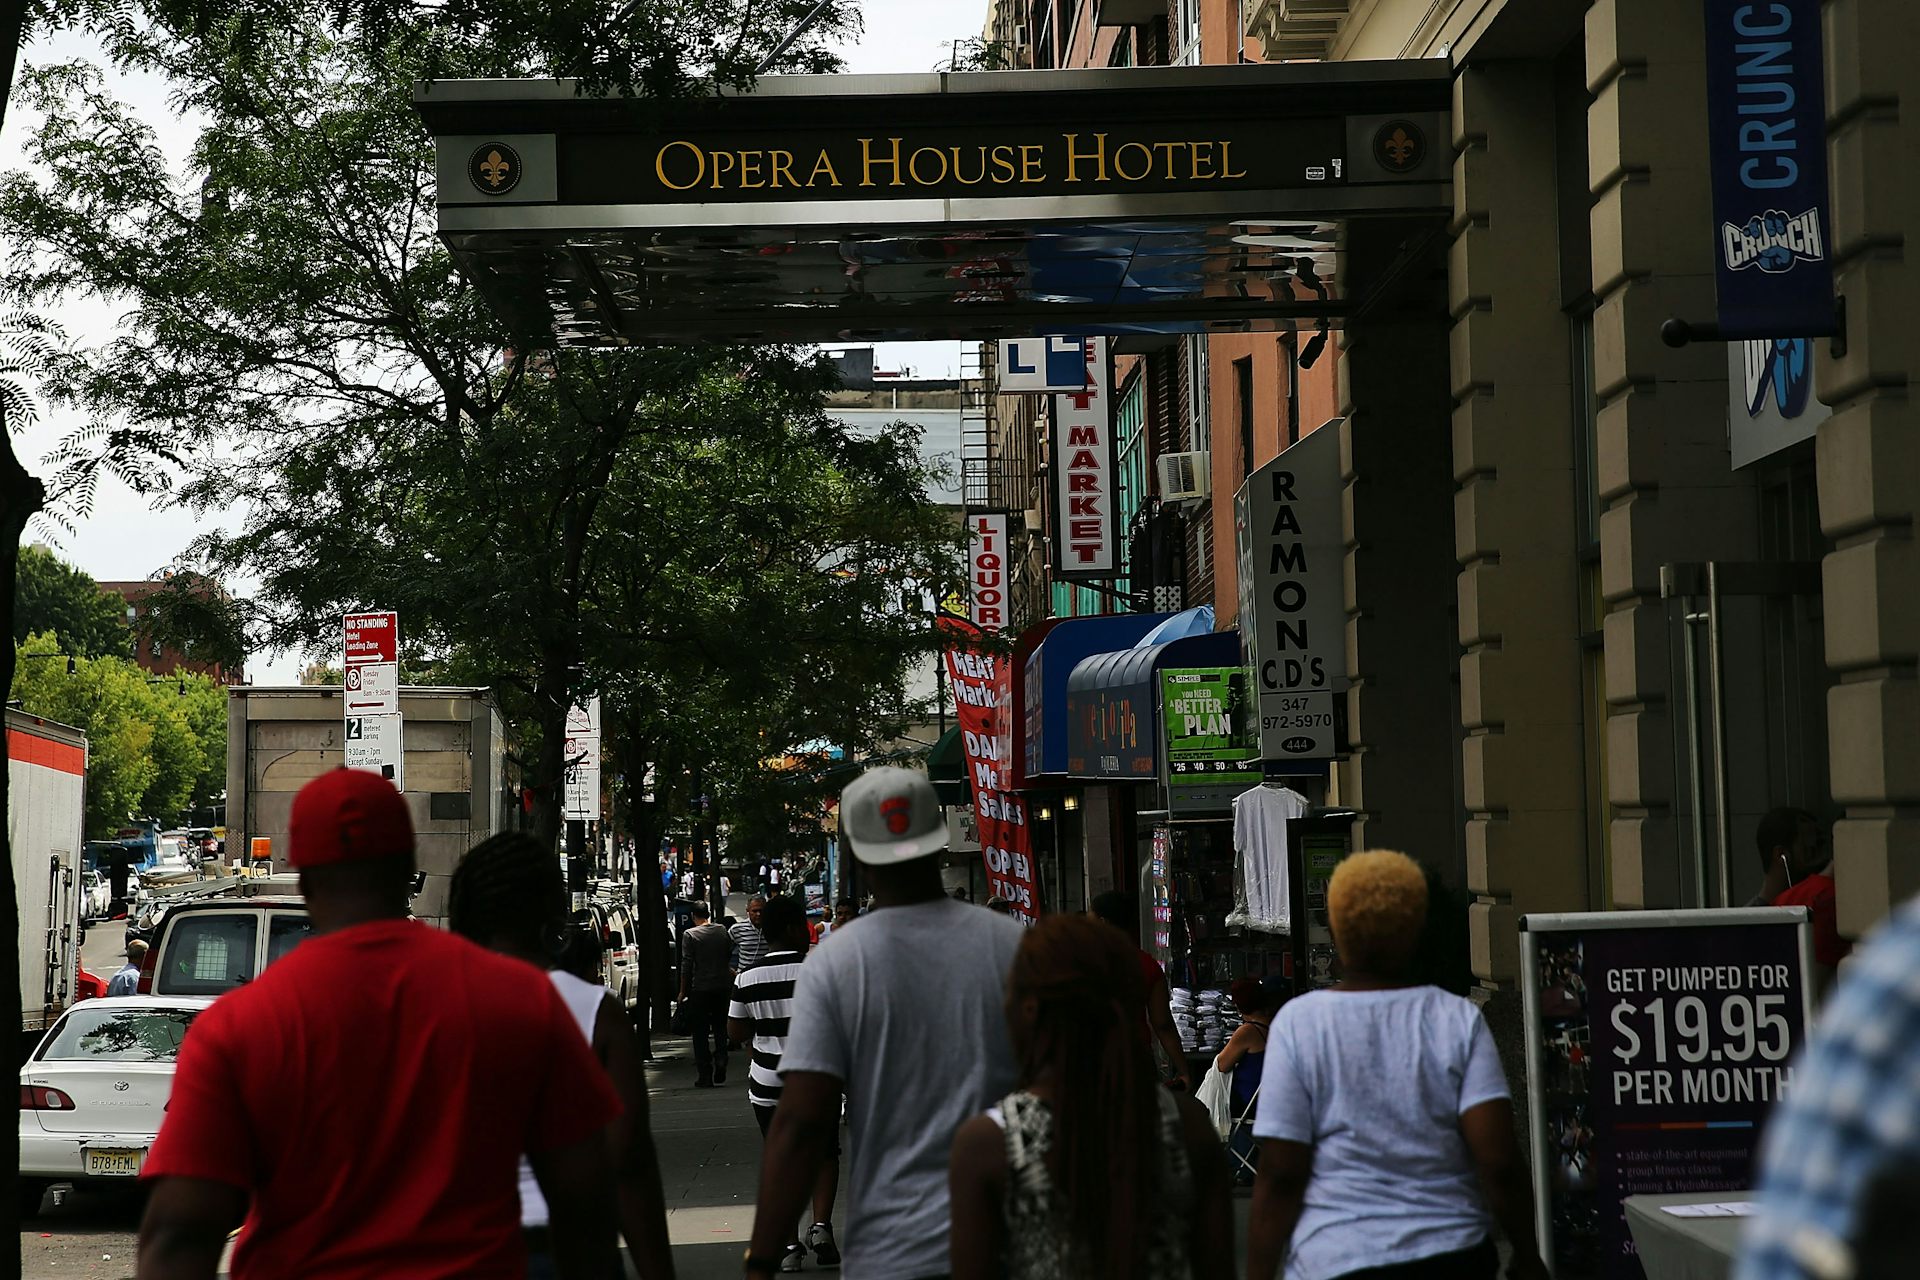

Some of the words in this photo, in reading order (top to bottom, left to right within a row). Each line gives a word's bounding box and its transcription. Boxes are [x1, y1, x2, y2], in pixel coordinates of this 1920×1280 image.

[655, 140, 843, 190] OPERA
[856, 137, 1046, 186] HOUSE
[1062, 132, 1247, 182] HOTEL
[1725, 212, 1821, 266] CRUNCH
[1066, 424, 1103, 564] MARKET
[1269, 470, 1308, 651] RAMON
[346, 620, 356, 629] NO
[356, 618, 389, 629] STANDING
[346, 632, 360, 640] Hotel
[346, 642, 366, 651] Loading
[366, 641, 379, 649] Zone
[363, 670, 379, 678] Tuesday
[951, 651, 995, 680] MEAT
[1181, 690, 1194, 698] YOU
[1194, 689, 1212, 698] NEED
[1174, 697, 1222, 715] BETTER
[1281, 698, 1309, 712] 347
[350, 718, 359, 738] 2
[1184, 713, 1232, 735] PLAN
[1262, 713, 1332, 730] 972-5970
[370, 748, 381, 756] 7pm
[1286, 739, 1307, 750] 444
[348, 758, 364, 767] Except
[364, 757, 383, 766] Sunday
[978, 791, 1024, 826] Sales
[985, 845, 1032, 883] OPEN
[1607, 968, 1646, 992] GET
[1652, 965, 1742, 992] PUMPED
[1748, 964, 1790, 989] FOR
[1610, 994, 1791, 1065] $19.95
[1613, 1068, 1673, 1105] PER
[1682, 1066, 1797, 1104] MONTH
